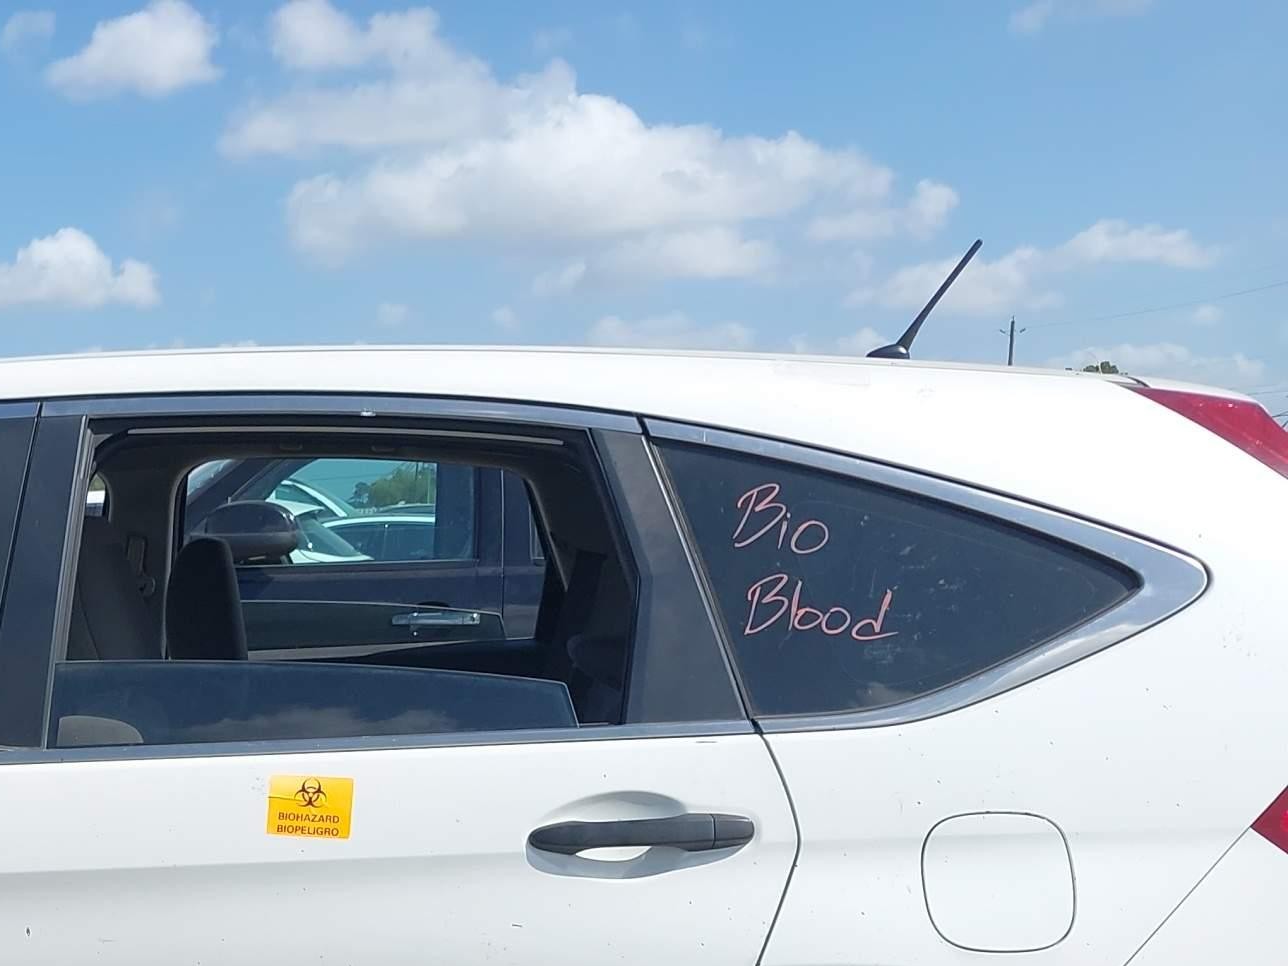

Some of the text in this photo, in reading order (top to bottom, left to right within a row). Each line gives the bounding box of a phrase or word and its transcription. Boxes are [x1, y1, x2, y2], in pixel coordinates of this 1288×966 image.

[744, 573, 899, 641] Blood
[277, 811, 340, 824] BIOHAZARD
[276, 824, 340, 837] BIOPELIGRO
